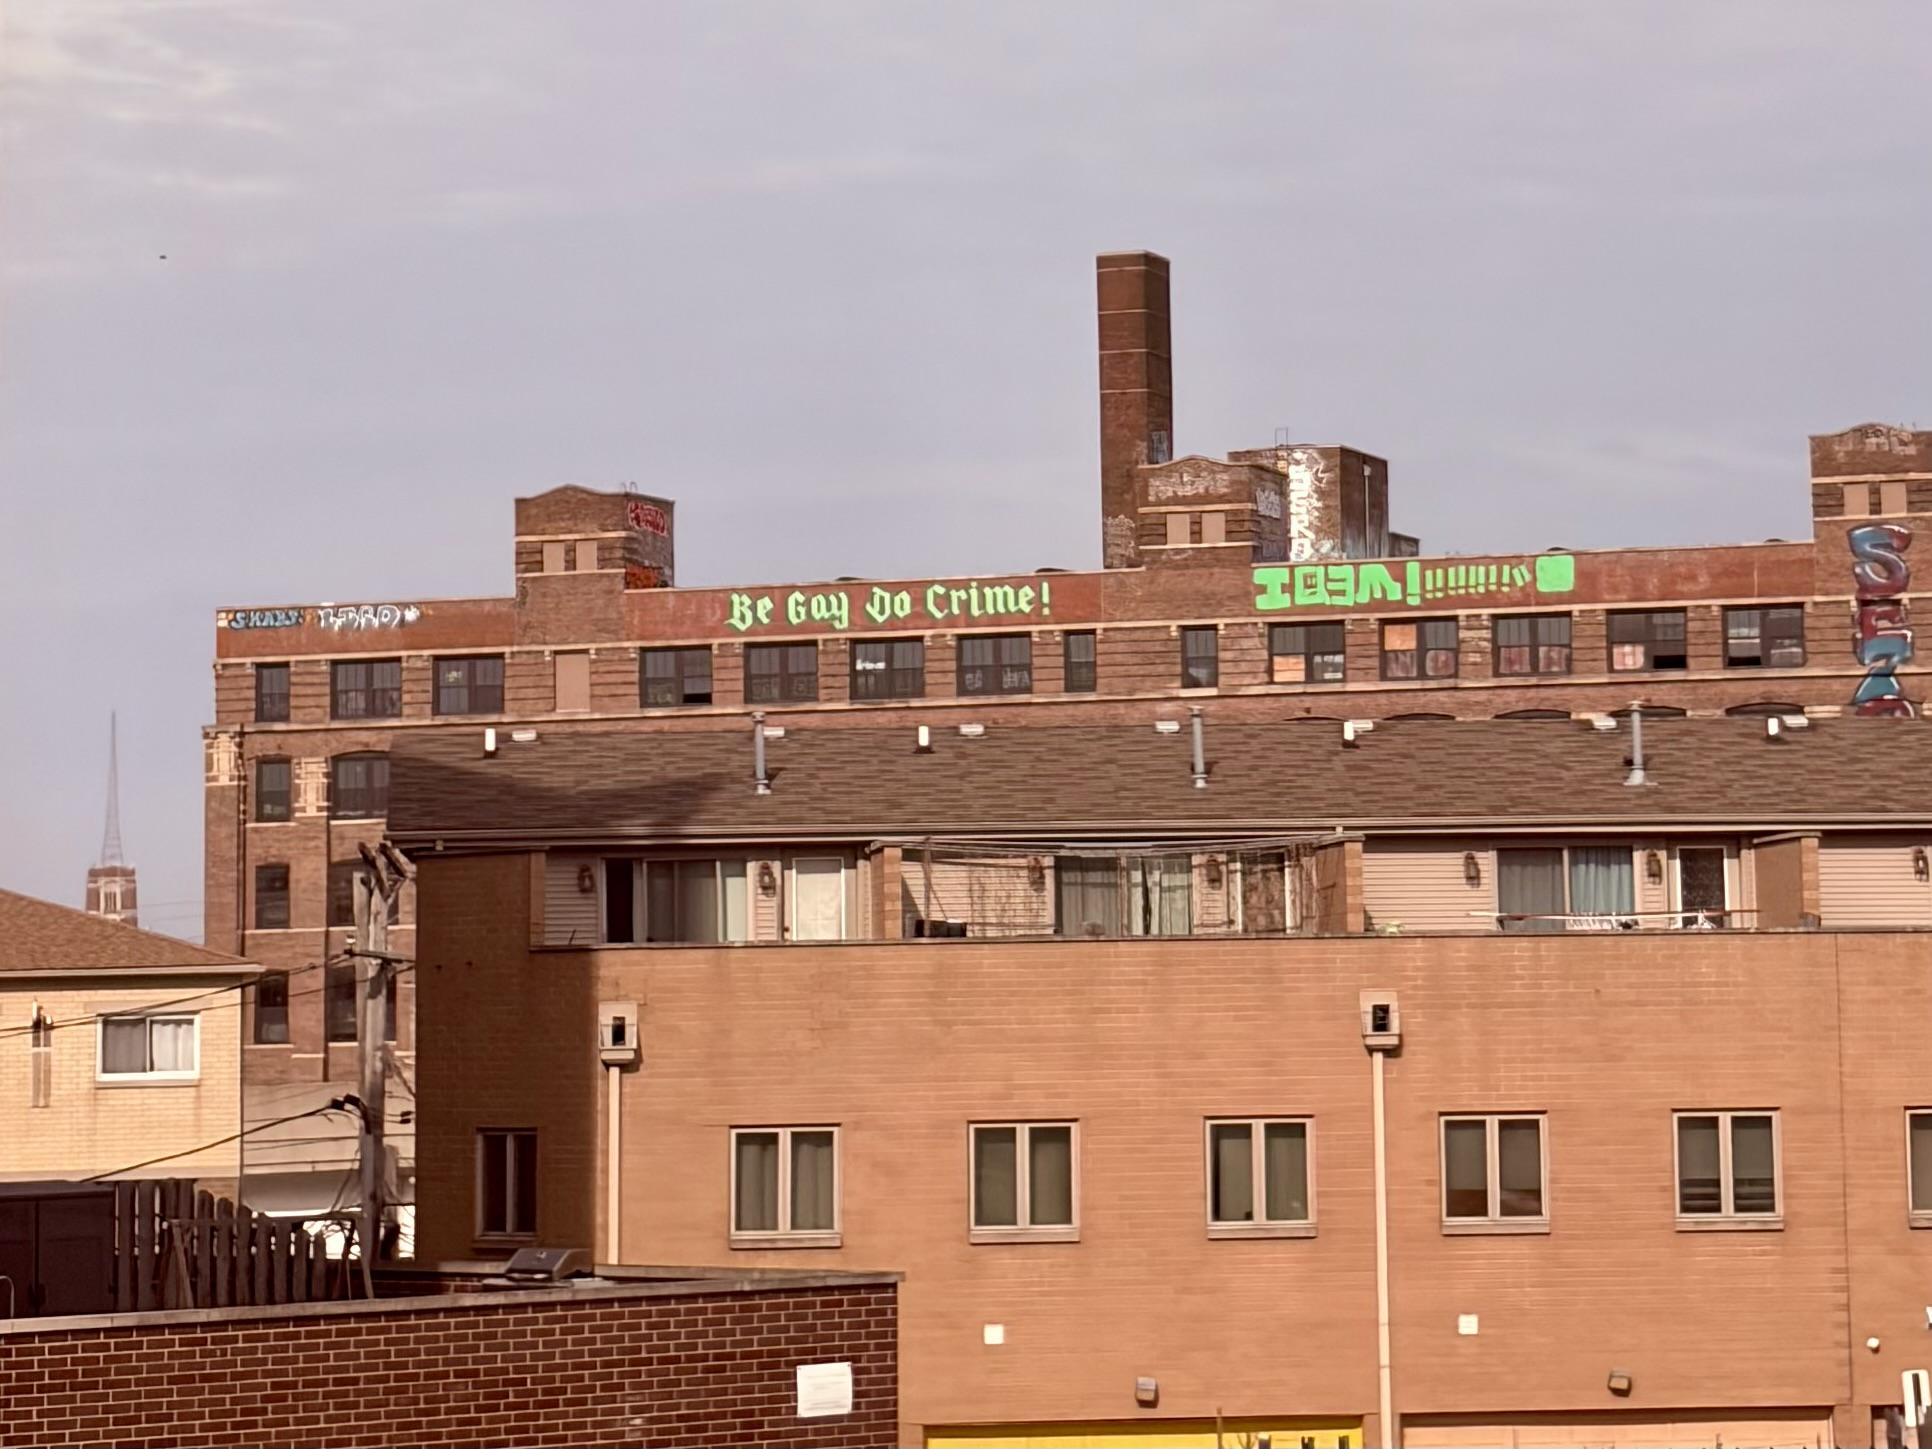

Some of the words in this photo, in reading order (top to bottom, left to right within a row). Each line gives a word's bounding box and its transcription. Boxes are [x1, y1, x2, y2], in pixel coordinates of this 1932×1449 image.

[724, 591, 774, 632] Be
[786, 590, 849, 629] Gay
[865, 585, 912, 624] Do
[925, 580, 1052, 619] Crime!
